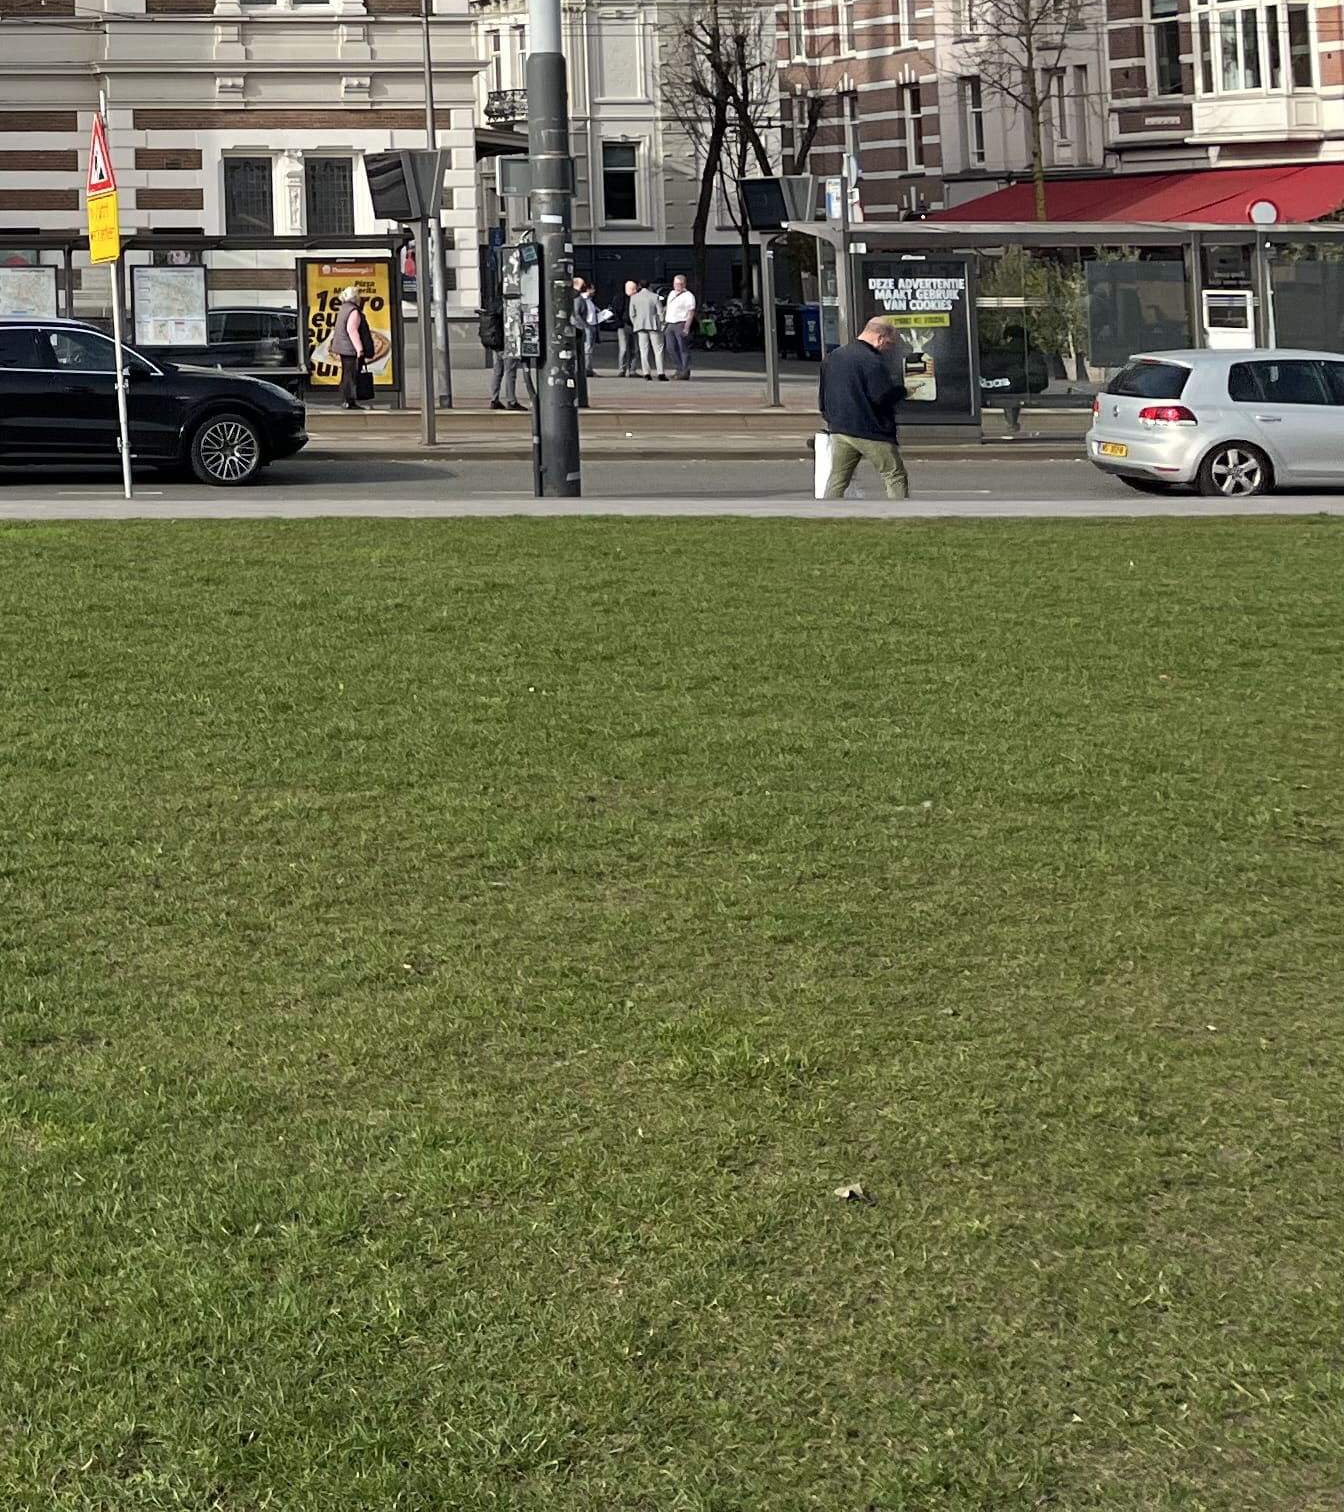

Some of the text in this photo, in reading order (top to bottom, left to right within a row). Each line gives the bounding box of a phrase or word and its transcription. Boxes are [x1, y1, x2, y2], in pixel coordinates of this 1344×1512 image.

[868, 278, 965, 289] DEZE ADVERTENTIE
[874, 289, 959, 300] MAAKT GEBRUIK
[883, 299, 953, 310] VAN COOKIES
